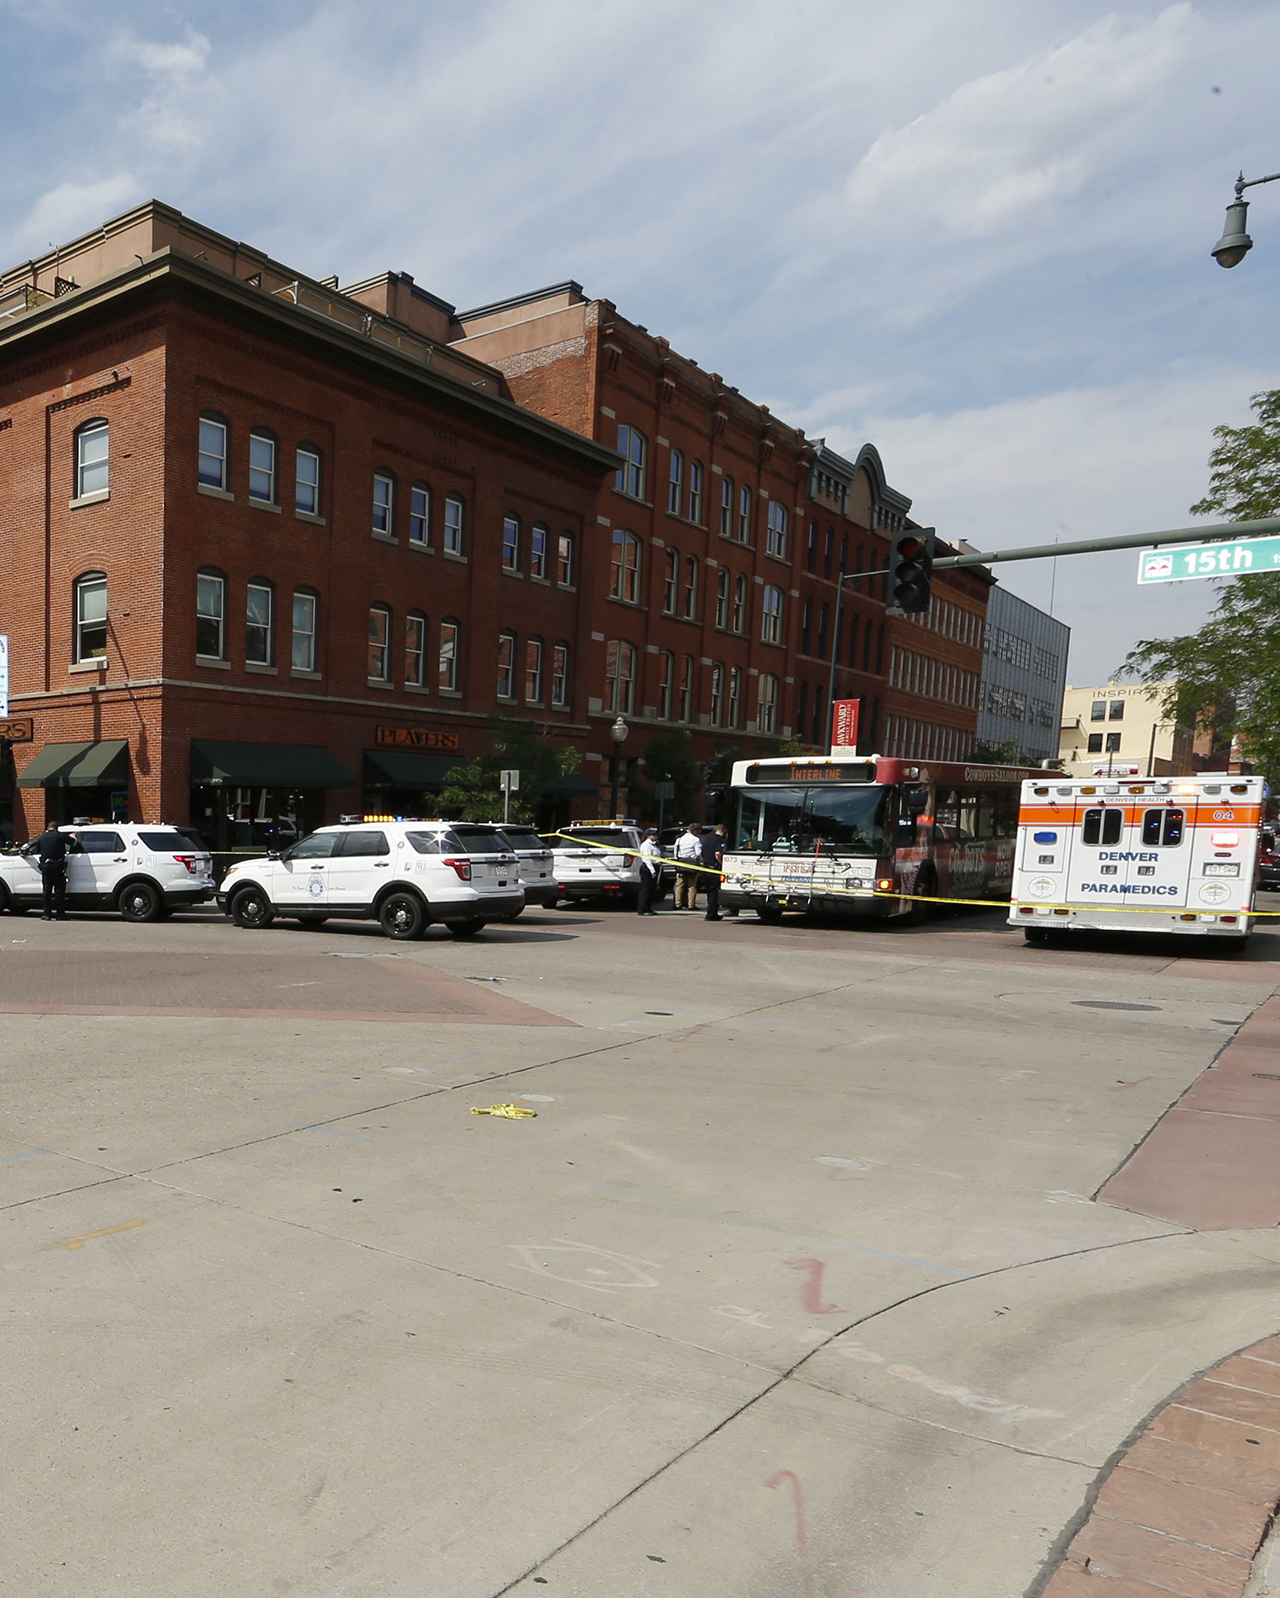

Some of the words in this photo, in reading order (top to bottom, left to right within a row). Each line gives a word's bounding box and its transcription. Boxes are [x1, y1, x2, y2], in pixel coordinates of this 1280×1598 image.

[1183, 546, 1253, 573] 15th
[836, 704, 847, 746] AWKWARD
[1213, 811, 1234, 821] 04
[1098, 852, 1160, 862] DENVER
[1081, 883, 1179, 896] PARAMEDICS
